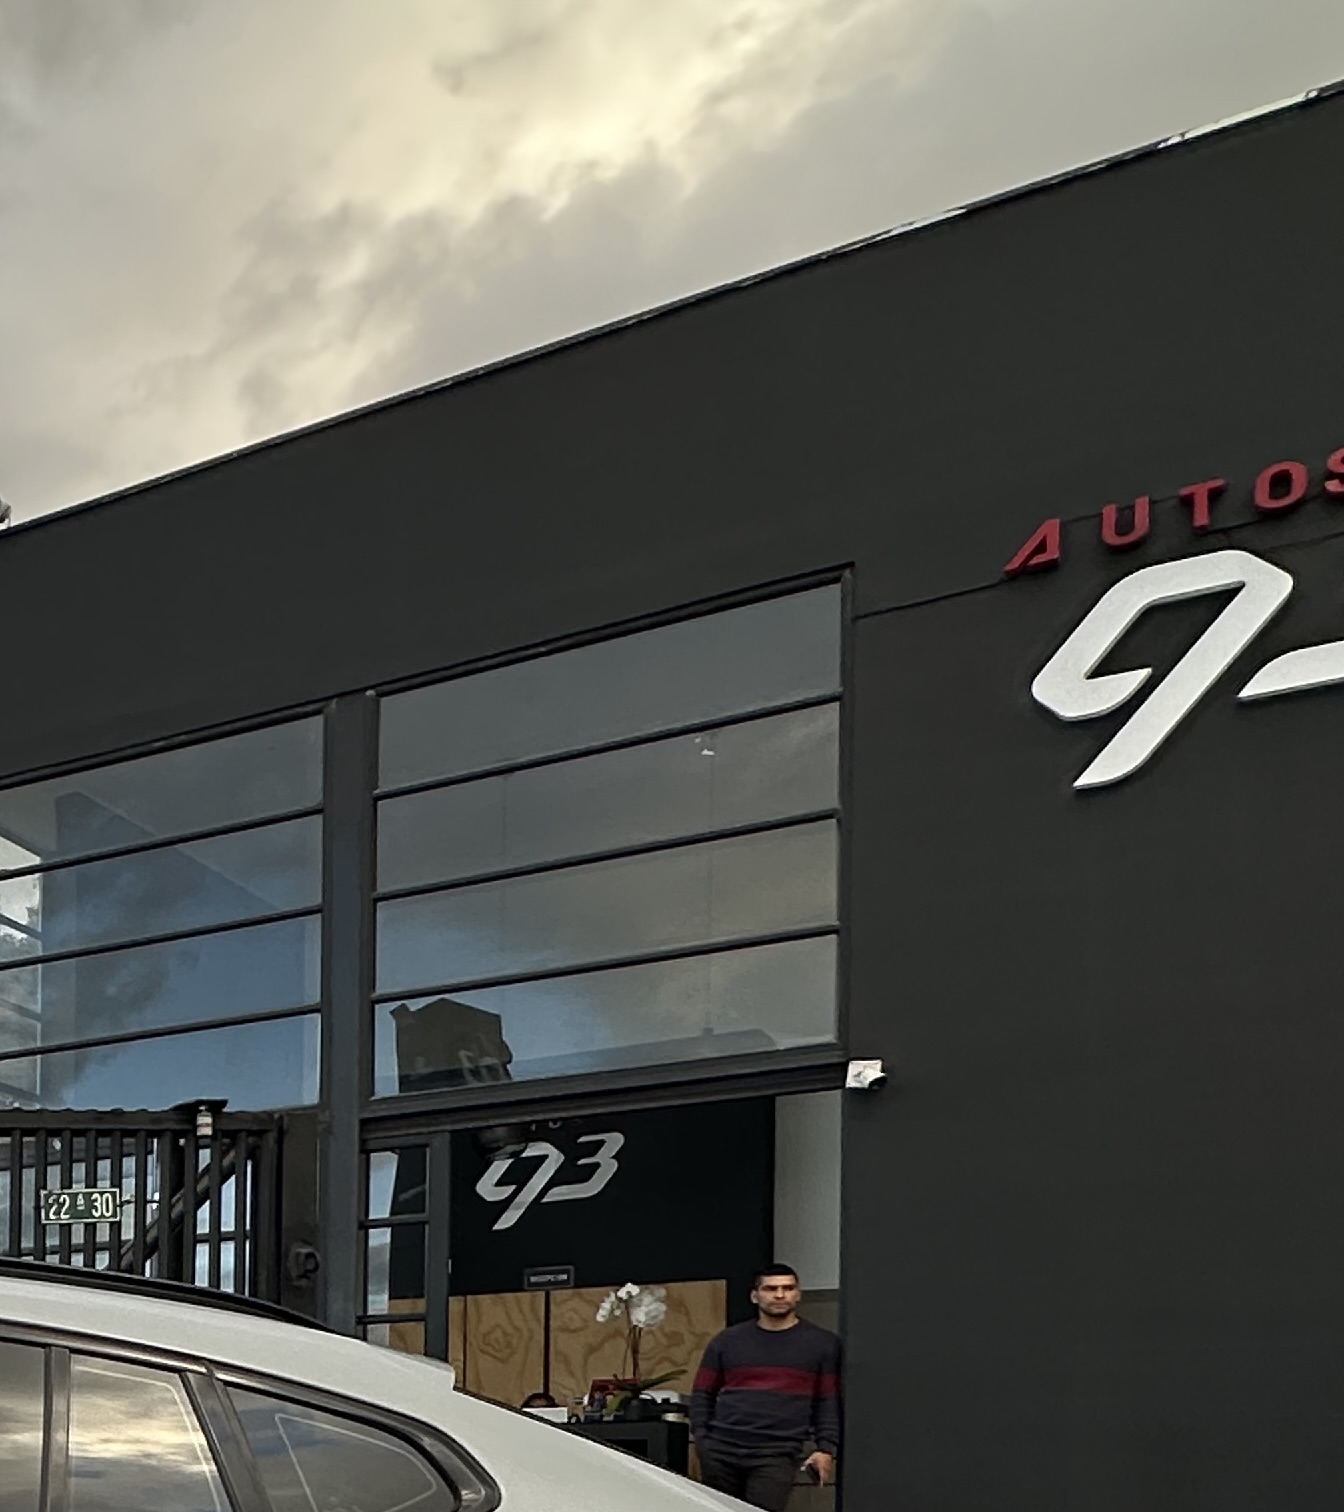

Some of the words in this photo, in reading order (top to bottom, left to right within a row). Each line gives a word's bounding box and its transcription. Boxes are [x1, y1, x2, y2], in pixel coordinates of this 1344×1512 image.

[1030, 549, 1344, 790] 9
[48, 1194, 71, 1219] 22
[91, 1192, 113, 1218] 30
[476, 1132, 625, 1230] 93
